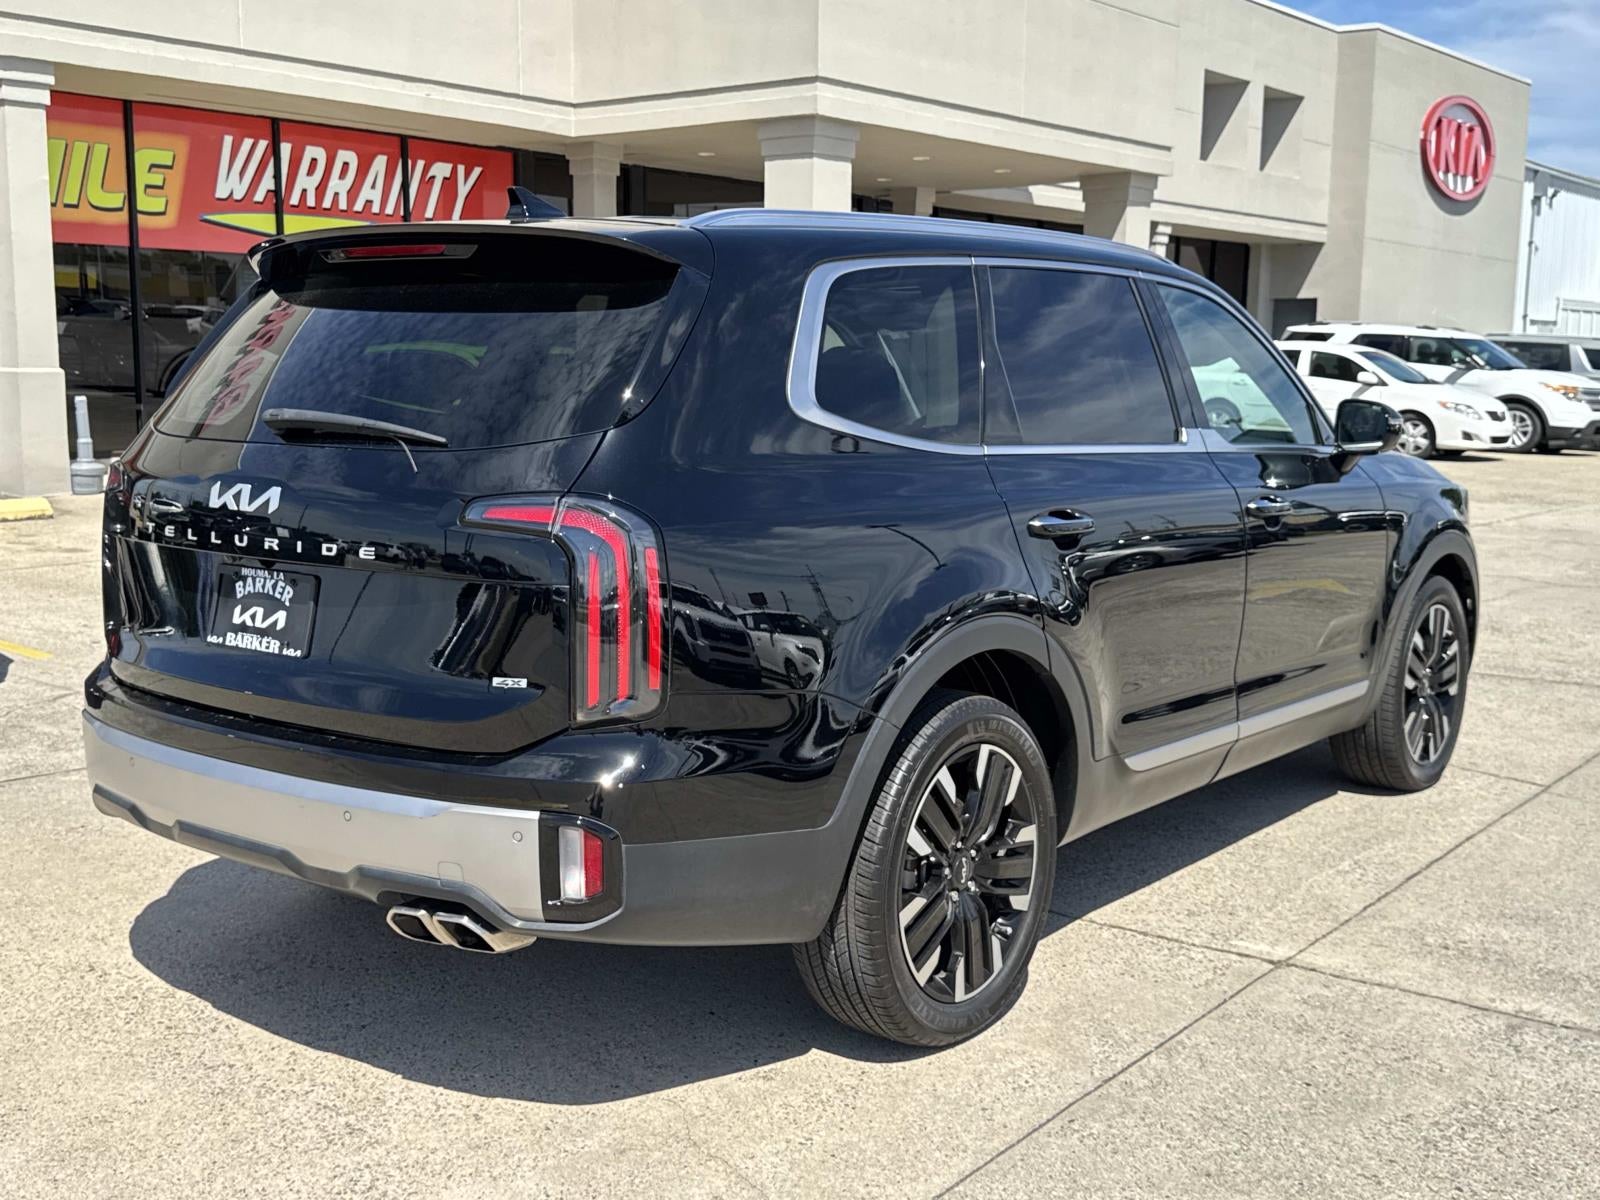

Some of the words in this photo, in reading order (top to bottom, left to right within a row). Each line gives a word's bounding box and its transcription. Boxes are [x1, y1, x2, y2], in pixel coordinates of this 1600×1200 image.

[1430, 116, 1486, 184] KIA
[213, 134, 484, 220] WARRANTY
[208, 480, 282, 514] KIA
[145, 522, 377, 560] TELLURIDE
[235, 577, 294, 607] BARKER
[232, 604, 287, 631] KIA
[225, 632, 281, 654] BARKER
